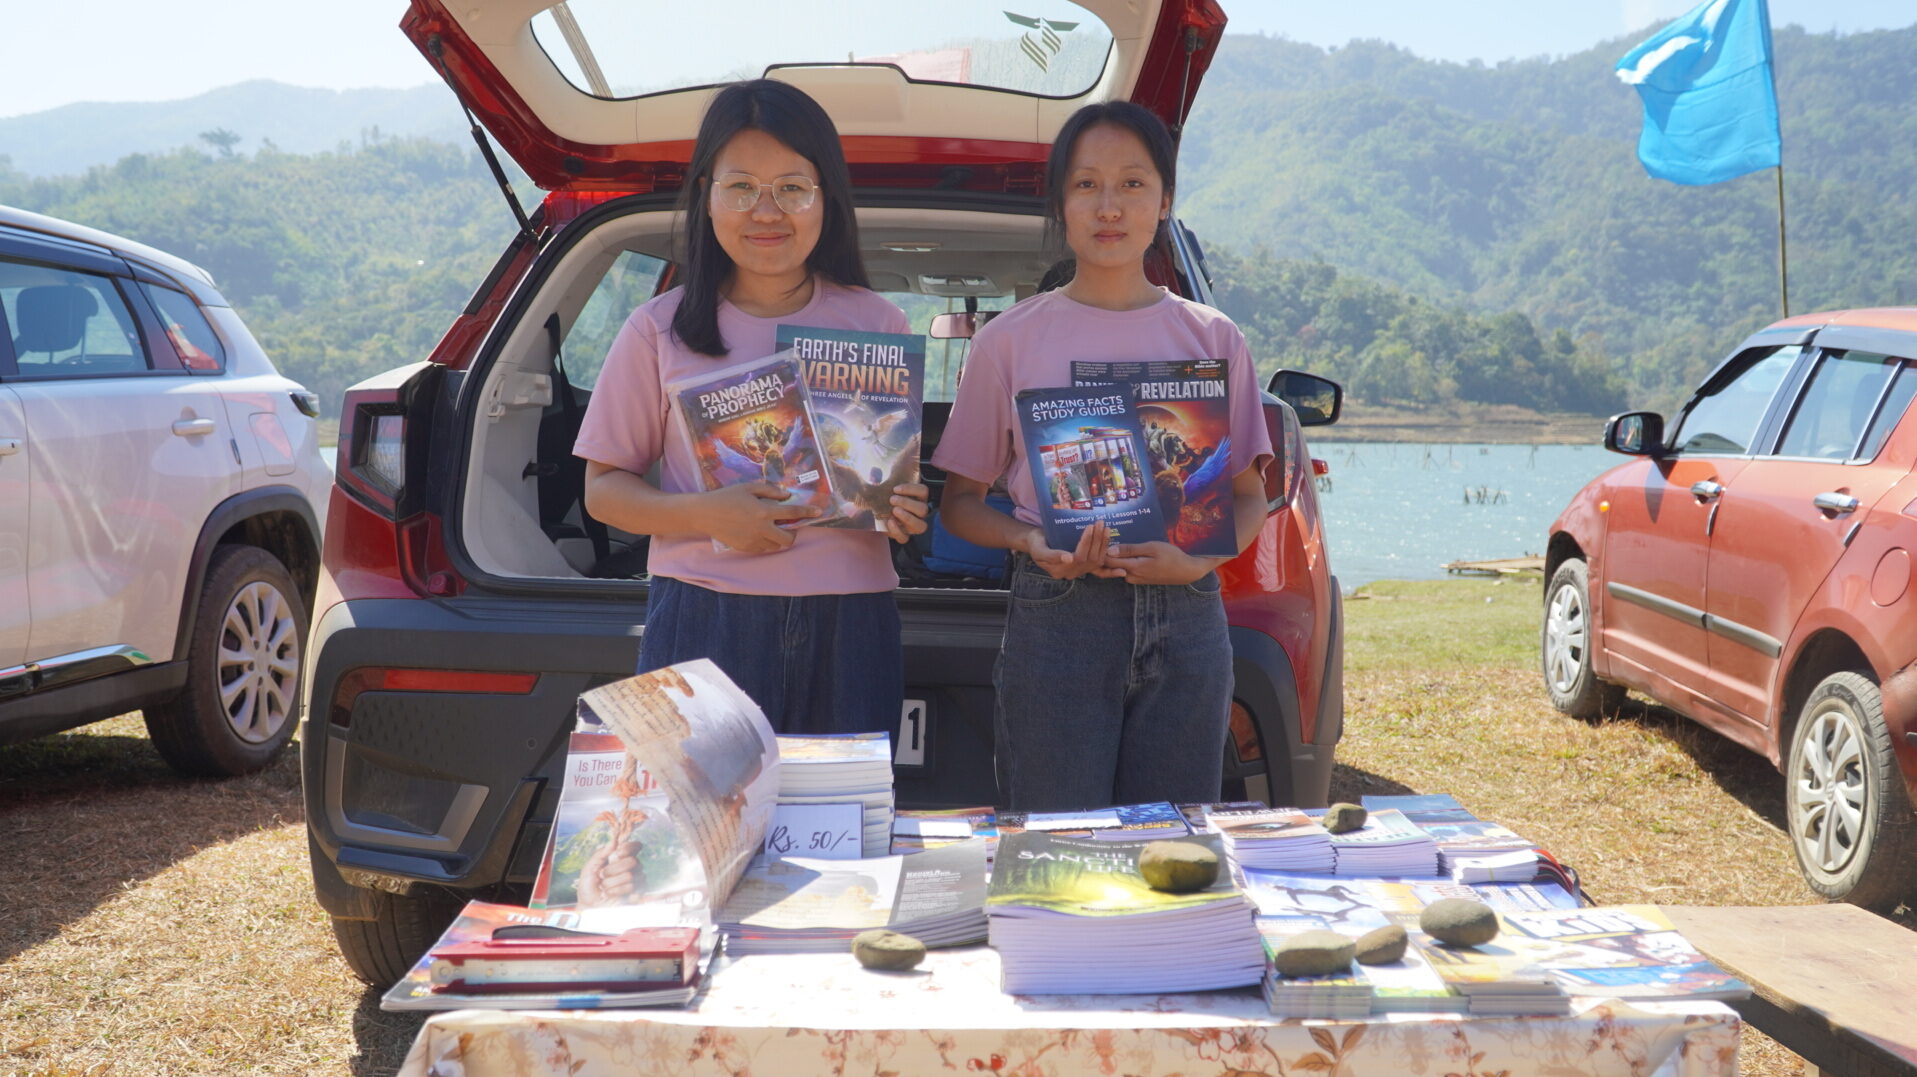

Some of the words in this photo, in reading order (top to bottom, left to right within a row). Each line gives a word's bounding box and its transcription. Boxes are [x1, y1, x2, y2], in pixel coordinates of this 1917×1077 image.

[793, 337, 858, 363] EARTH'S
[863, 343, 907, 367] FINAL
[699, 374, 784, 408] PANORAMA
[1141, 380, 1225, 400] REVELATION
[707, 384, 785, 419] PROPHECY
[870, 395, 909, 404] REVELATION
[1031, 399, 1085, 412] AMAZING
[1087, 395, 1123, 407] FACTS
[1033, 408, 1075, 422] STUDY
[1079, 404, 1125, 417] GUIDES
[1055, 516, 1094, 524] Introductory
[908, 707, 921, 750] 1
[578, 760, 589, 773] Is
[591, 759, 622, 771] There
[574, 775, 594, 787] You
[595, 773, 617, 786] Can
[767, 826, 800, 854] Rs.
[808, 830, 859, 851] 50/-
[1017, 850, 1135, 867] SANCTI
